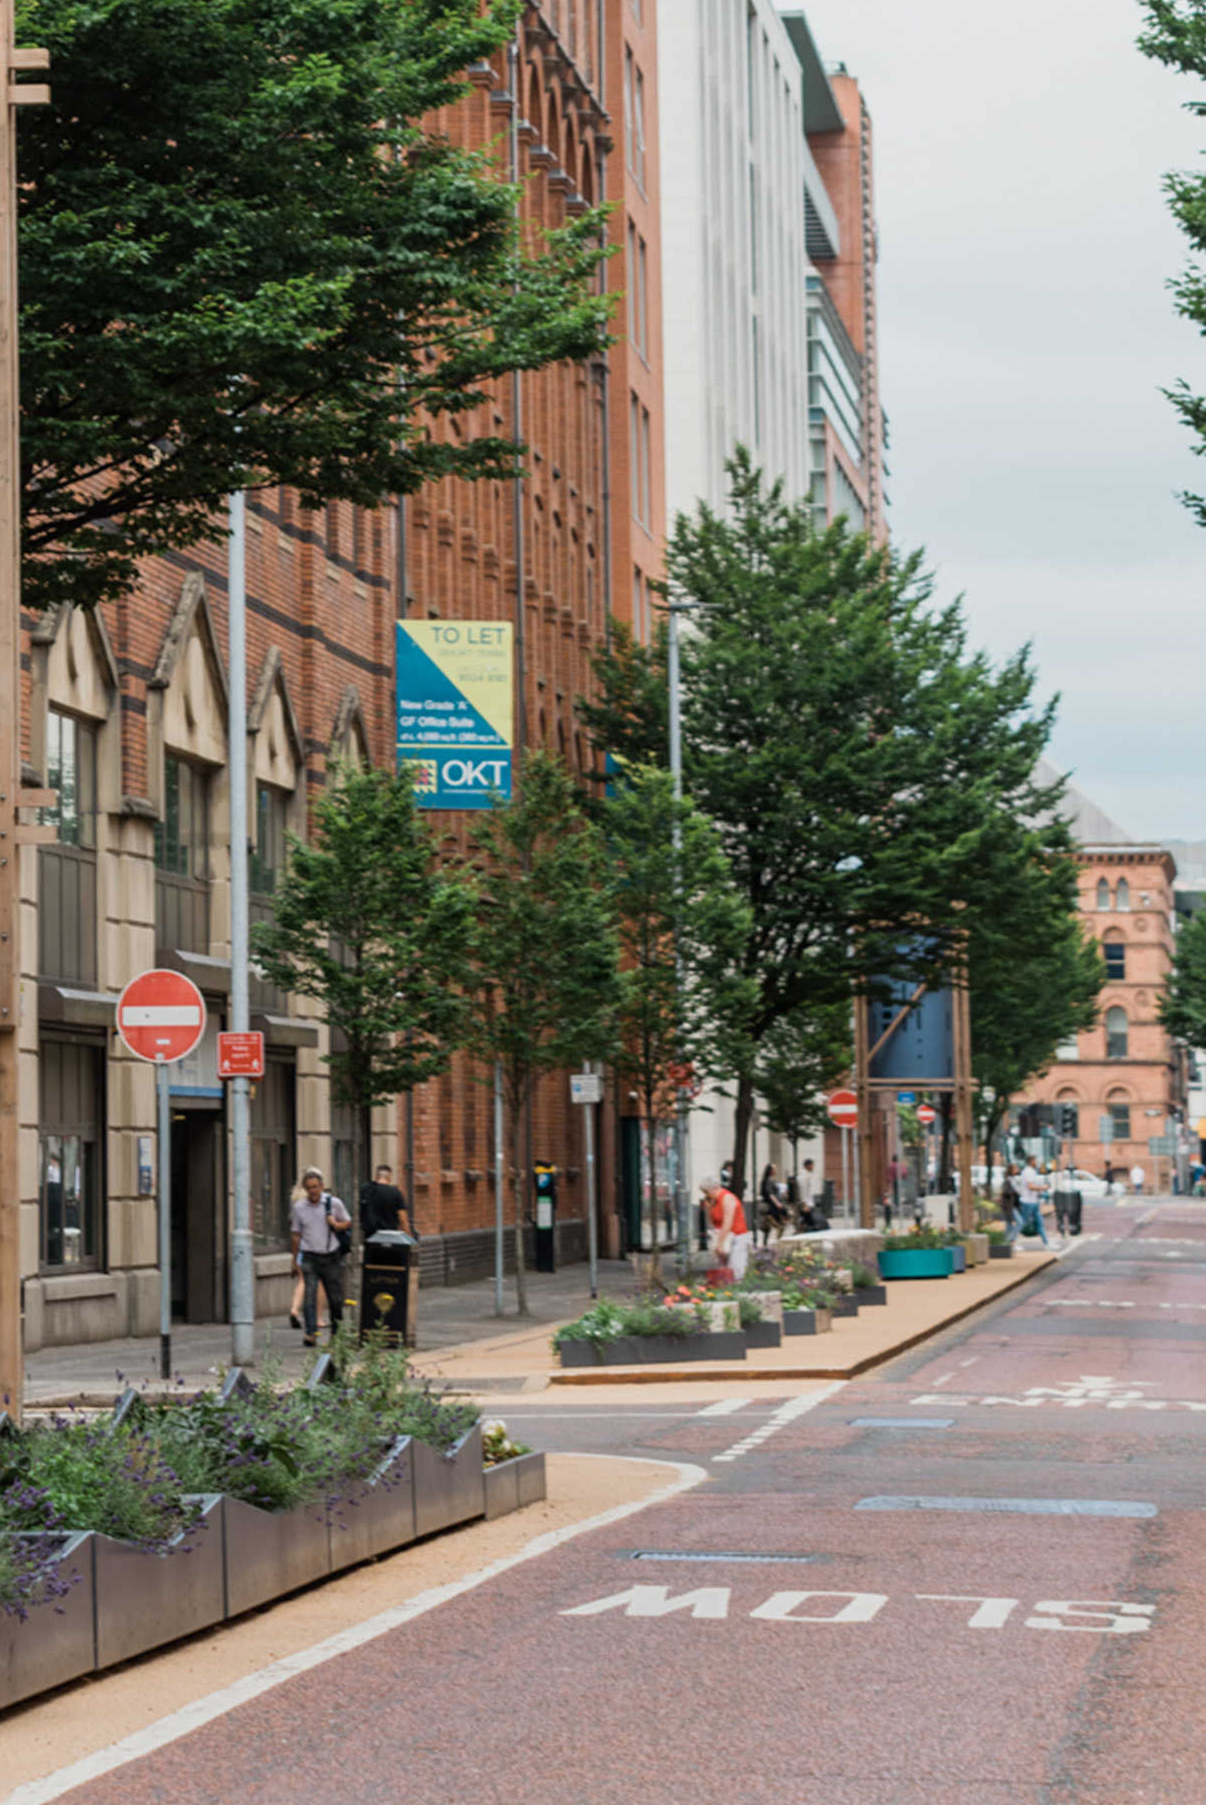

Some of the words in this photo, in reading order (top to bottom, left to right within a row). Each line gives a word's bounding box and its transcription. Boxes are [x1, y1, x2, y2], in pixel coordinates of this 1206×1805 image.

[431, 627, 460, 644] TO
[467, 627, 506, 644] LET
[425, 700, 454, 710] Grade
[400, 716, 415, 726] GF
[418, 716, 447, 727] Office
[449, 717, 475, 727] Suite
[442, 760, 508, 786] OKT
[1024, 1387, 1145, 1399] NO
[558, 1584, 1159, 1633] SLOW
